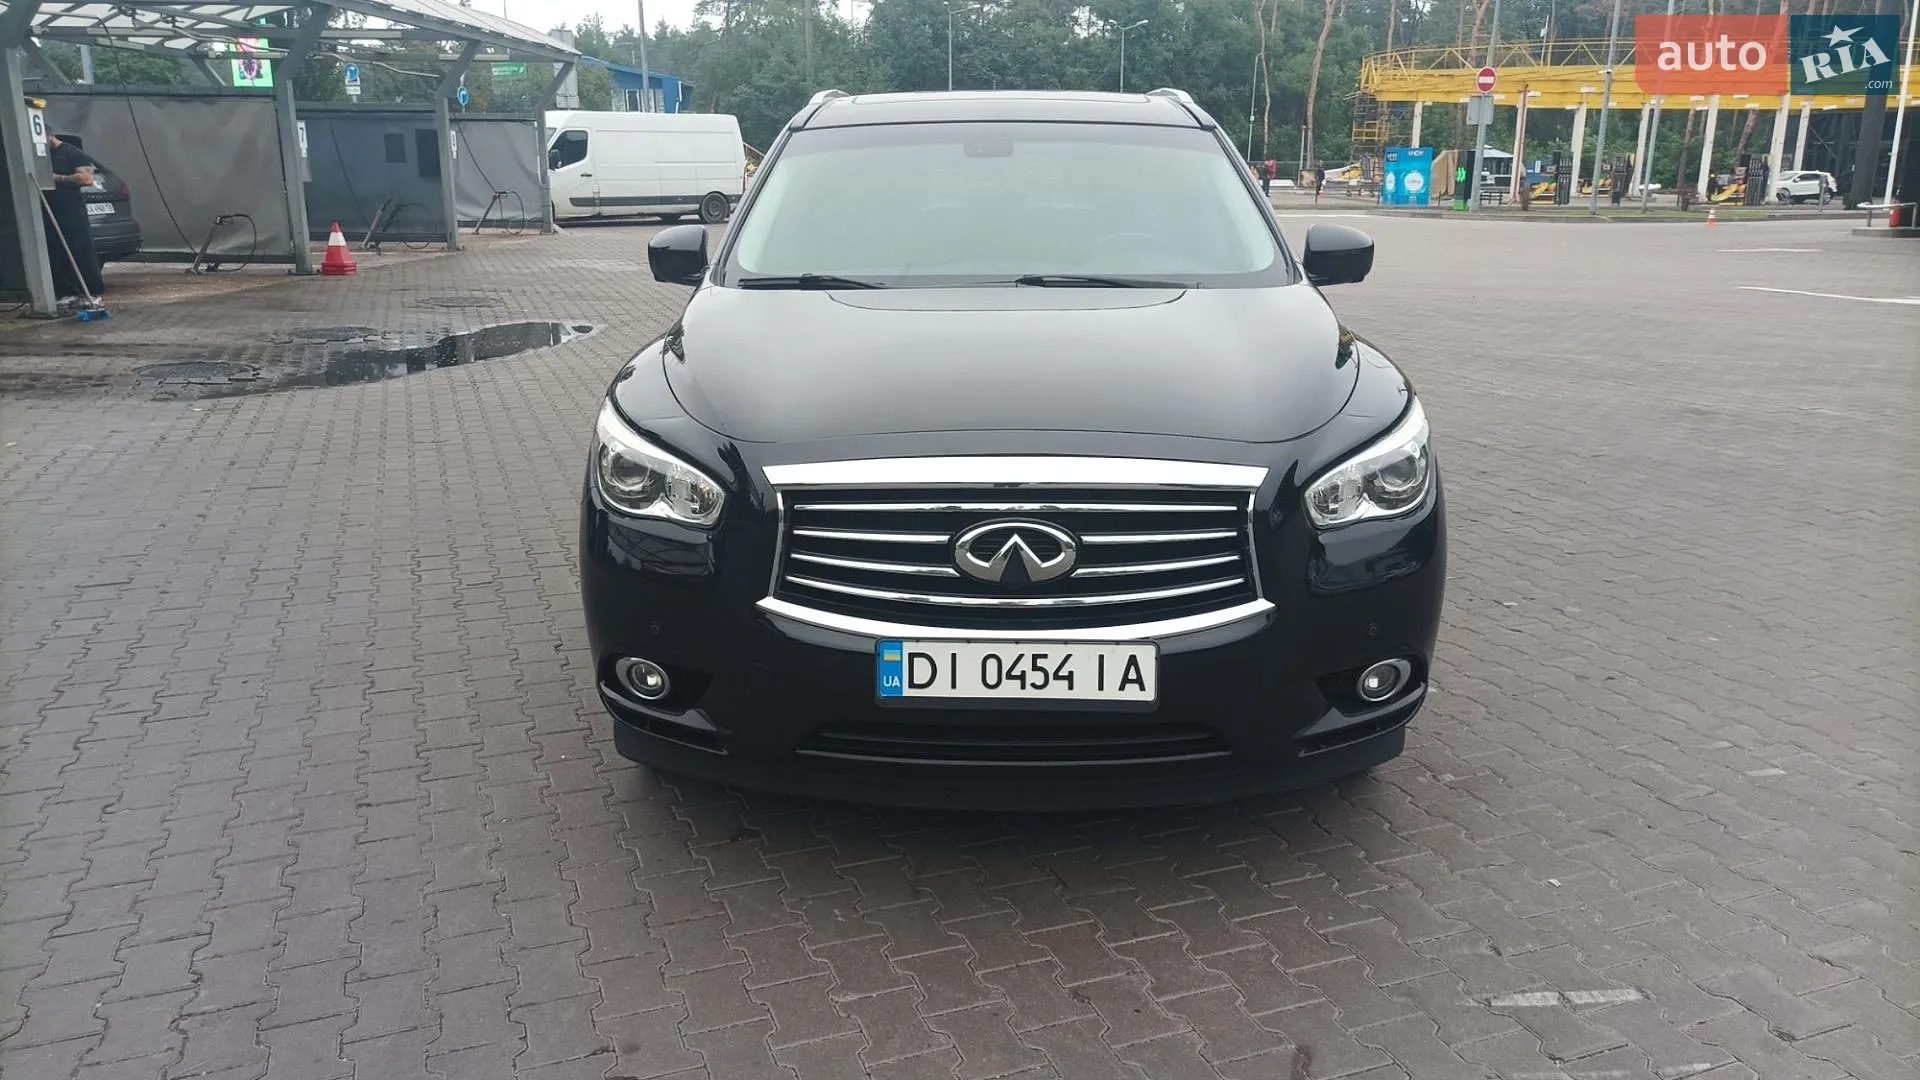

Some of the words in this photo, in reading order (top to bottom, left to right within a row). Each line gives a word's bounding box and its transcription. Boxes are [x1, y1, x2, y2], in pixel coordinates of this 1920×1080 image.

[32, 114, 43, 137] 6
[883, 675, 901, 688] UA
[907, 652, 957, 690] DI
[980, 653, 1074, 691] 0454
[1097, 654, 1146, 692] IA
